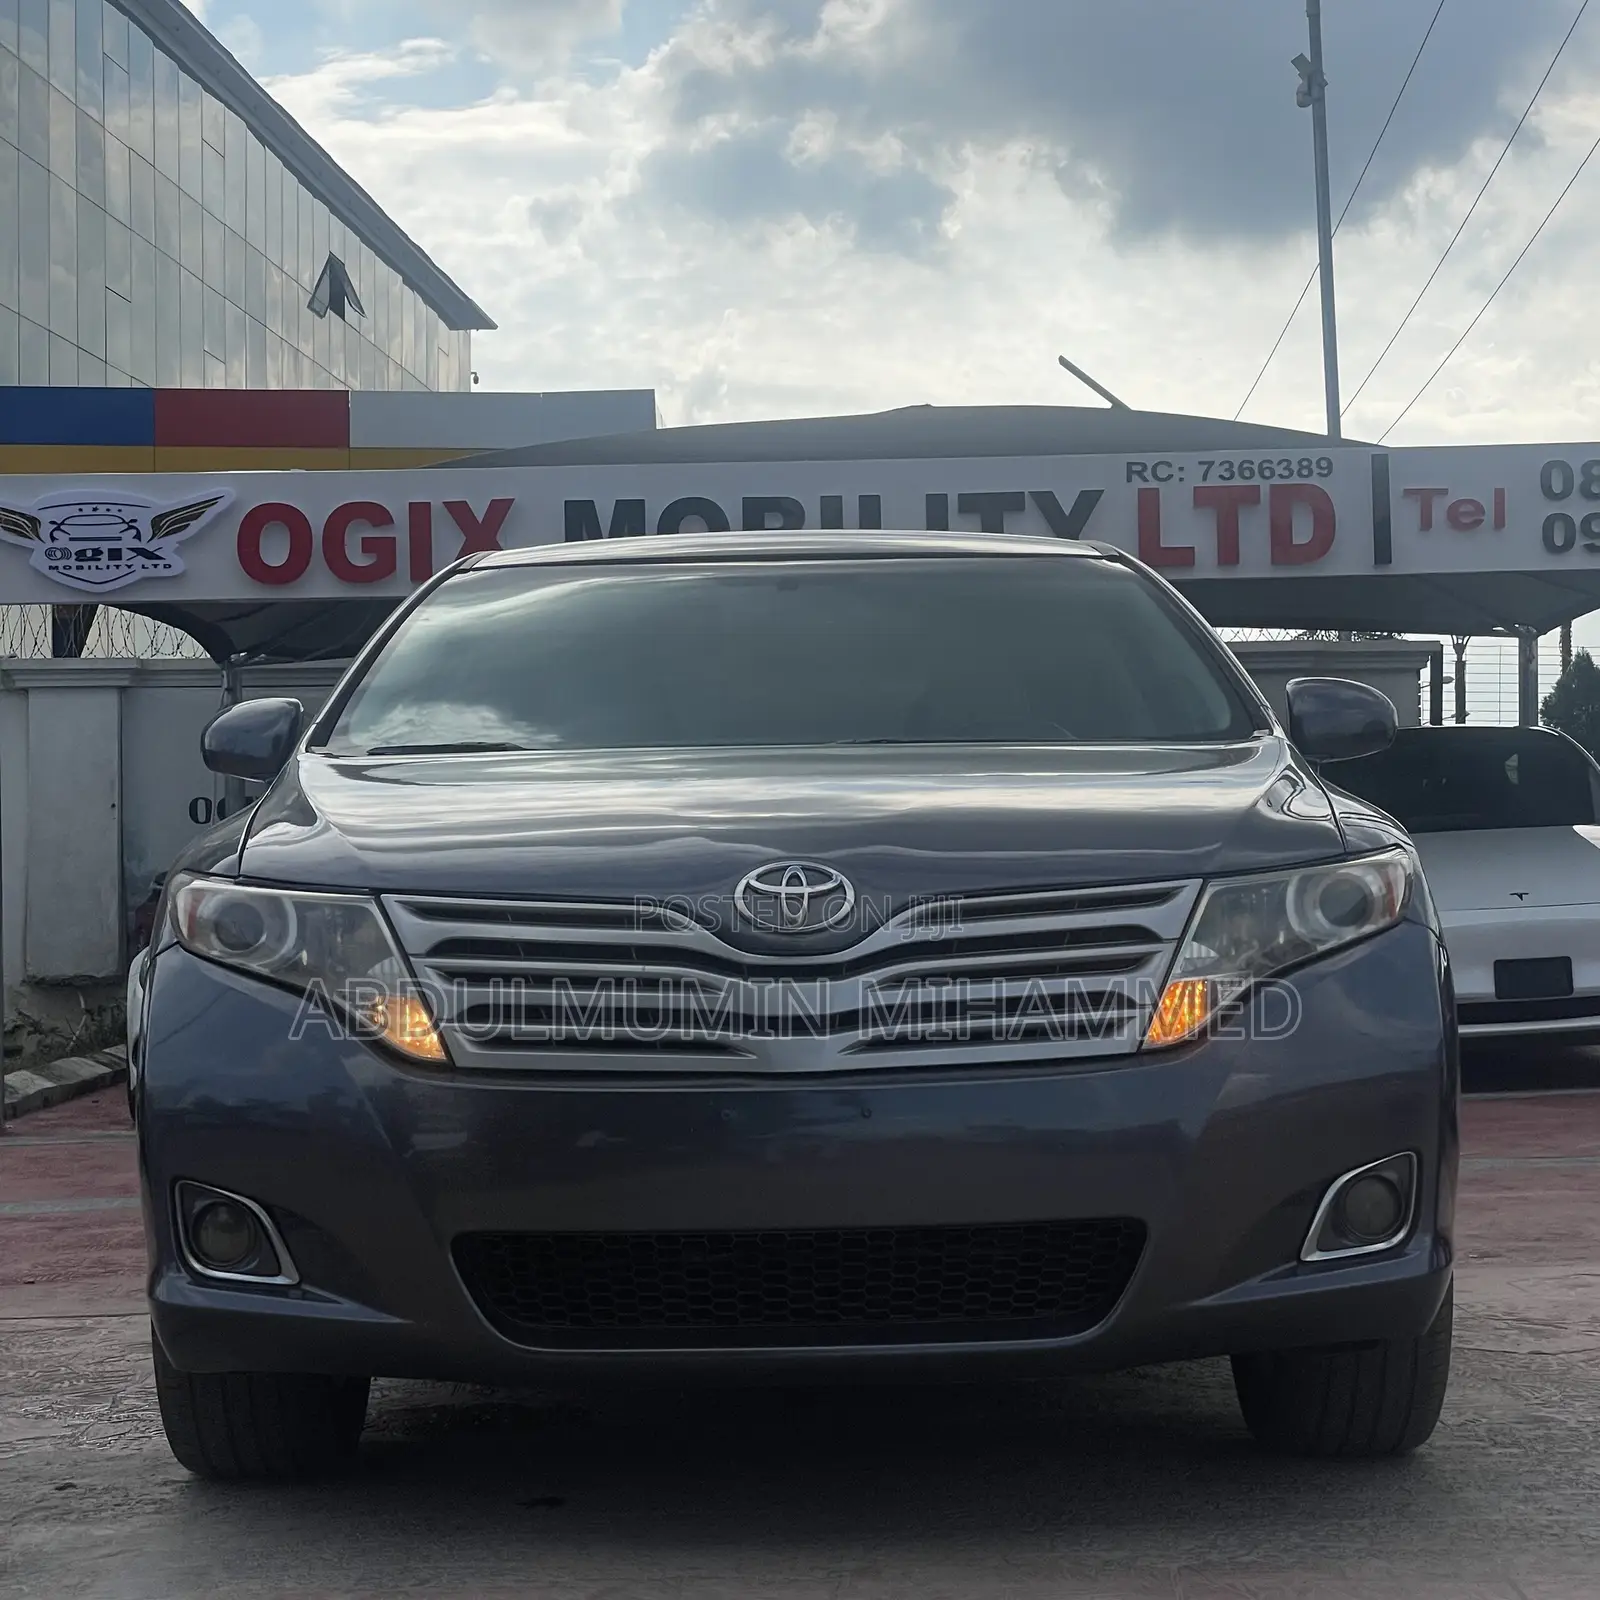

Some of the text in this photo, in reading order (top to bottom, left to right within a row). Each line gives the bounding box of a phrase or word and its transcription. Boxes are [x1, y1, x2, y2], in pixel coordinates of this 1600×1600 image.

[1126, 456, 1334, 482] RC: 7366389
[237, 498, 515, 586] OGIX
[1137, 483, 1336, 566] LTD
[1403, 487, 1506, 532] Tel
